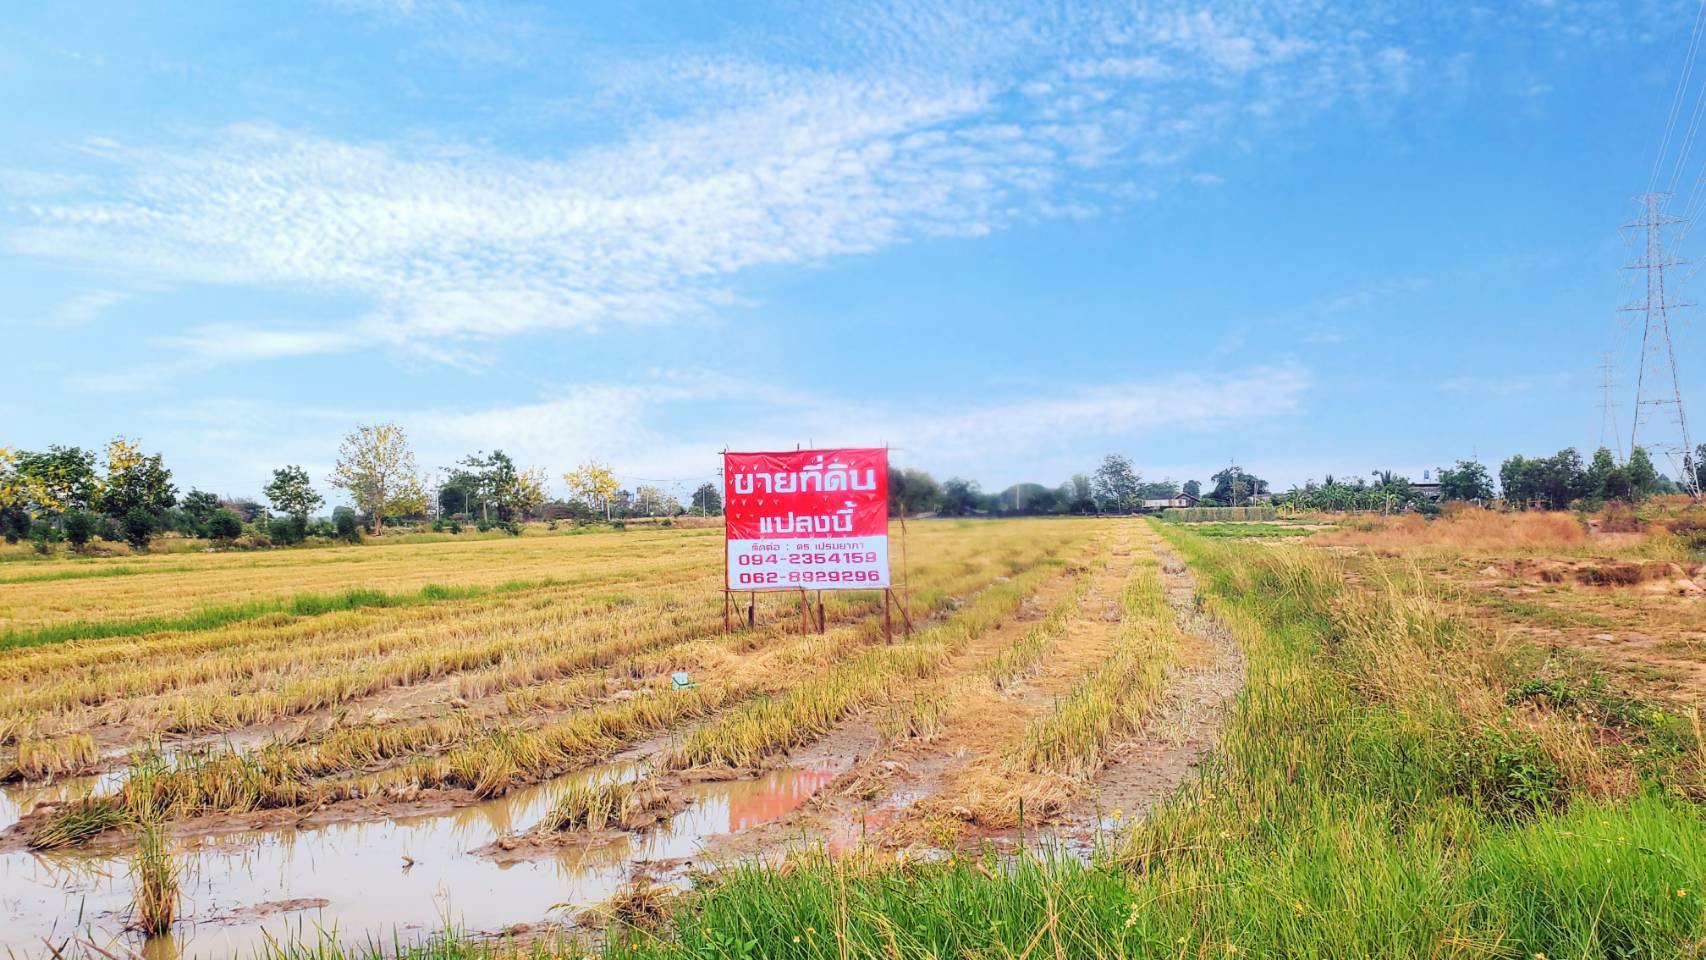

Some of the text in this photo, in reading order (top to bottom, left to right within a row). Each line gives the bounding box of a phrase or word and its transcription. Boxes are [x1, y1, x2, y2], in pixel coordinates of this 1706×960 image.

[735, 455, 876, 494] ขายที่ดิน
[760, 501, 857, 533] แปลงนี้
[738, 552, 876, 566] 094-2354159
[739, 570, 880, 584] 062-8929296
